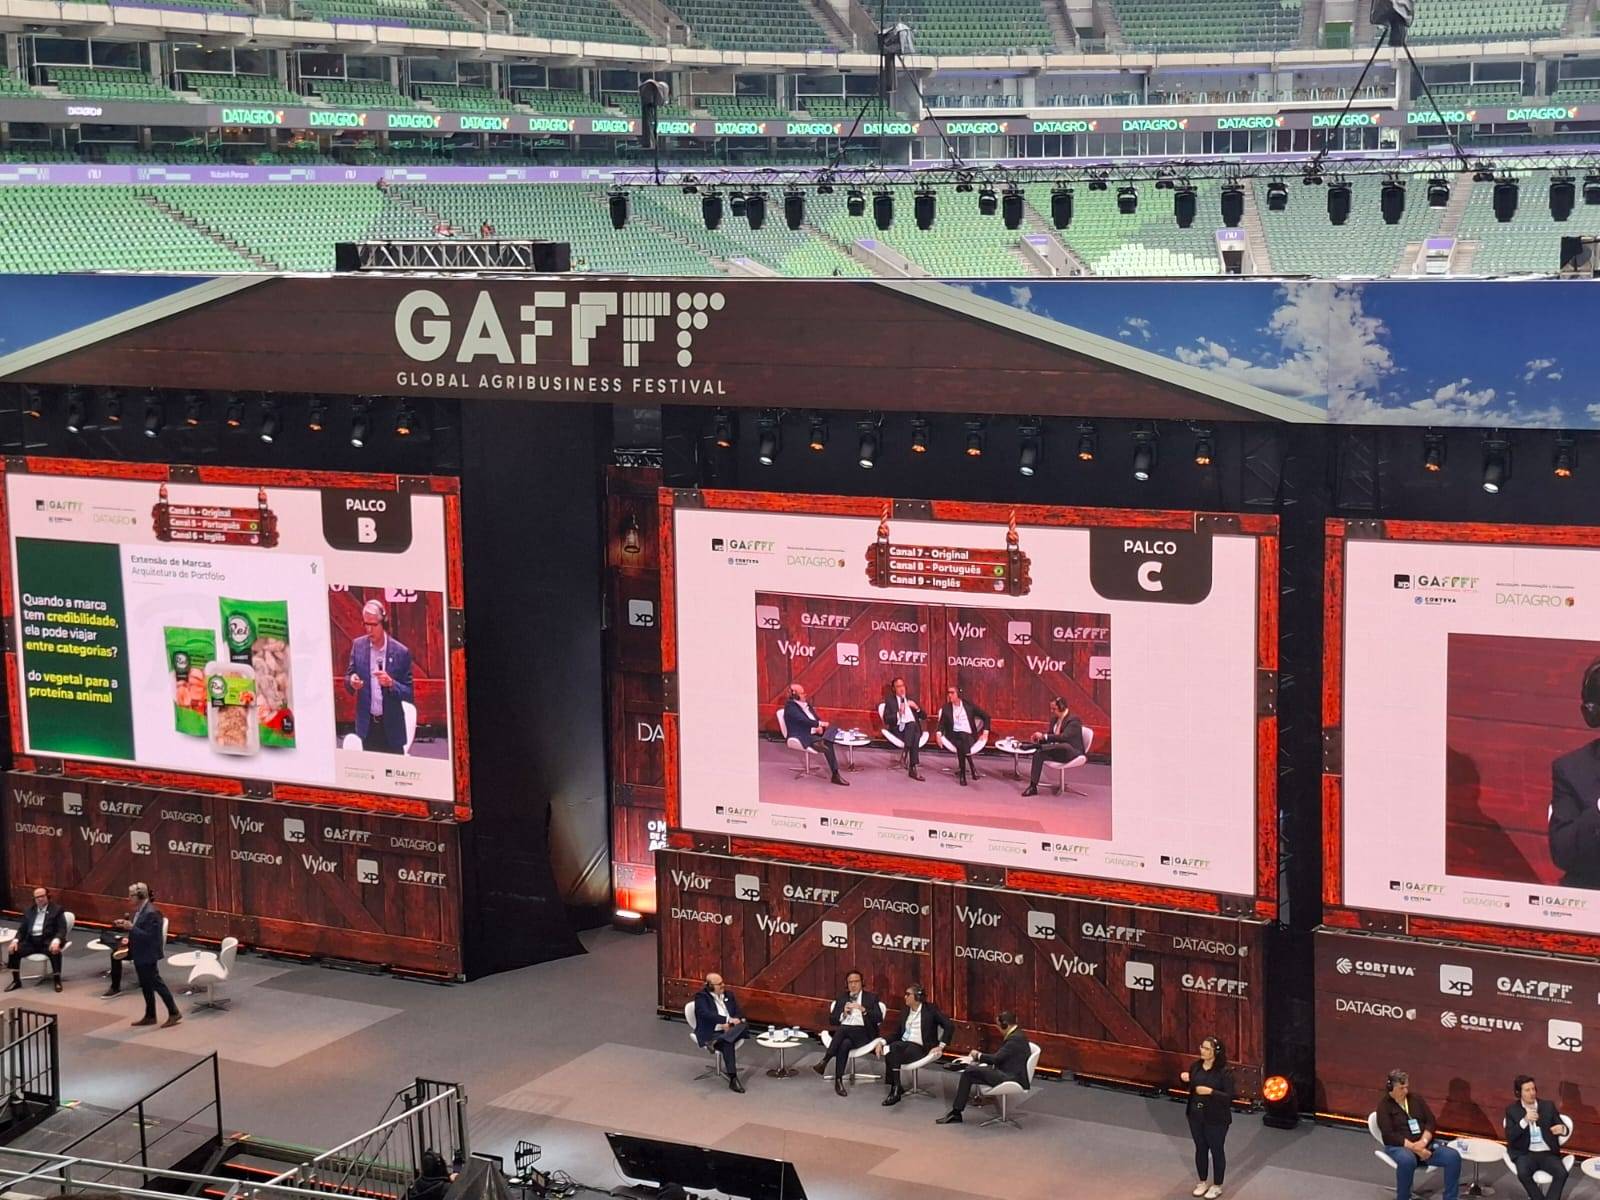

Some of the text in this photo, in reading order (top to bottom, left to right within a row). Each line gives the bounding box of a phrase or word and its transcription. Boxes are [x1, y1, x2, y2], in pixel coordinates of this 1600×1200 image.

[223, 109, 273, 124] DATAGRO
[310, 112, 358, 126] DATAGRO
[388, 114, 433, 129] DATAGRO
[1313, 114, 1370, 126] DATAGRO
[1408, 111, 1465, 124] DATAGRO
[1507, 108, 1565, 121] DATAGRO
[461, 117, 502, 130] DATAGRO
[529, 119, 568, 131] DATAGRO
[592, 120, 628, 132] DATAGRO
[656, 122, 689, 133] ATAGRO
[715, 122, 757, 134] DATAGRO
[787, 123, 832, 135] DATAGRO
[864, 123, 912, 135] DATAGRO
[947, 123, 998, 134] DATAGRO
[1034, 121, 1086, 133] DATAGRO
[1123, 119, 1177, 132] DATAGRO
[1218, 117, 1274, 129] DATAGRO
[397, 372, 726, 394] GLOBAL AGRIBUSINESS FESTIVAL
[168, 506, 189, 515] Canal
[202, 508, 232, 518] Original
[346, 498, 386, 512] PALCO
[170, 518, 190, 526] Canal
[358, 516, 378, 543] B
[171, 531, 192, 539] Canal
[890, 547, 916, 556] Canal
[917, 548, 923, 556] 7
[932, 550, 968, 560] Original
[1124, 540, 1176, 554] PALCO
[131, 554, 212, 568] Extensão de Marcas
[787, 556, 836, 568] DATAGRO
[890, 560, 916, 570] Canal
[932, 564, 981, 576] Português
[132, 567, 176, 578] Arquitetura
[1138, 561, 1163, 592] C
[890, 574, 916, 585] Canal
[918, 576, 924, 585] 9
[932, 578, 960, 589] Inglês
[23, 594, 106, 610] Quando a marca
[1496, 593, 1562, 607] DATAGRO
[24, 610, 118, 628] tem credibilidade,
[872, 620, 918, 633] DATAGRO
[25, 624, 97, 642] ela pode viajar
[949, 622, 986, 640] Vylor
[26, 642, 118, 658] entre categorias?
[778, 640, 816, 660] Vylor
[948, 656, 996, 668] DATAGRO
[1026, 656, 1066, 674] Vylor
[28, 670, 118, 688] do vegetal para a
[29, 686, 112, 704] proteína animal
[14, 789, 46, 808] Vylor
[161, 809, 204, 824] DATAGRO
[230, 814, 264, 834] Vylor
[16, 822, 56, 837] DATAGRO
[80, 826, 112, 846] Vylor
[390, 836, 437, 852] DATAGRO
[231, 850, 274, 865] DATAGRO
[302, 854, 337, 874] Vylor
[671, 869, 712, 892] Vylor
[864, 896, 919, 916] DATAGRO
[671, 906, 723, 925] DATAGRO
[955, 904, 1001, 928] Vylor
[756, 913, 798, 936] Vylor
[1172, 936, 1236, 957] DATAGRO
[955, 945, 1012, 965] DATAGRO
[1050, 952, 1098, 978] Vylor
[1355, 960, 1415, 977] CORTEVA
[1336, 998, 1403, 1020] DATAGRO
[1460, 1014, 1522, 1032] CORTEVA
